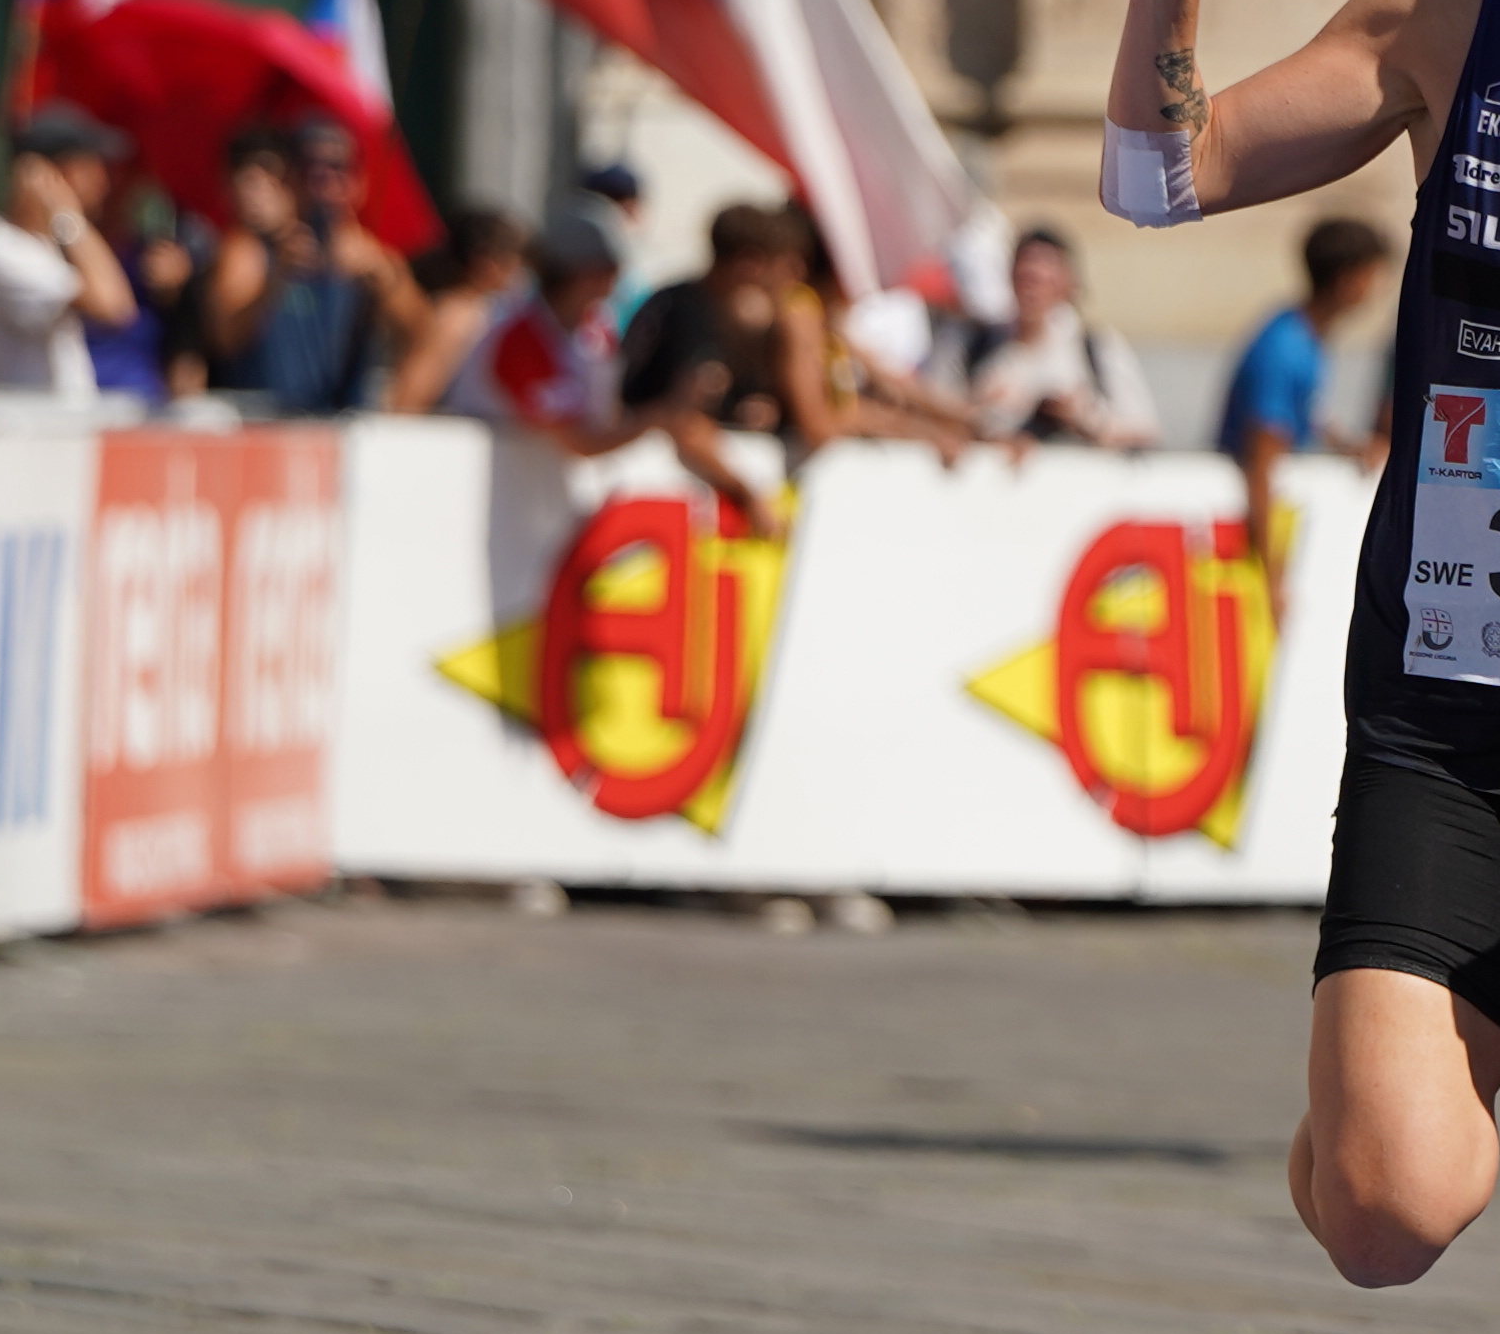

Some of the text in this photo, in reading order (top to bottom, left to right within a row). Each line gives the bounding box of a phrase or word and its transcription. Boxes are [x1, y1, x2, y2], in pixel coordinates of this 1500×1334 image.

[1463, 160, 1499, 184] Idre
[1428, 466, 1483, 481] T-KARTOR
[1413, 559, 1475, 588] SWE
